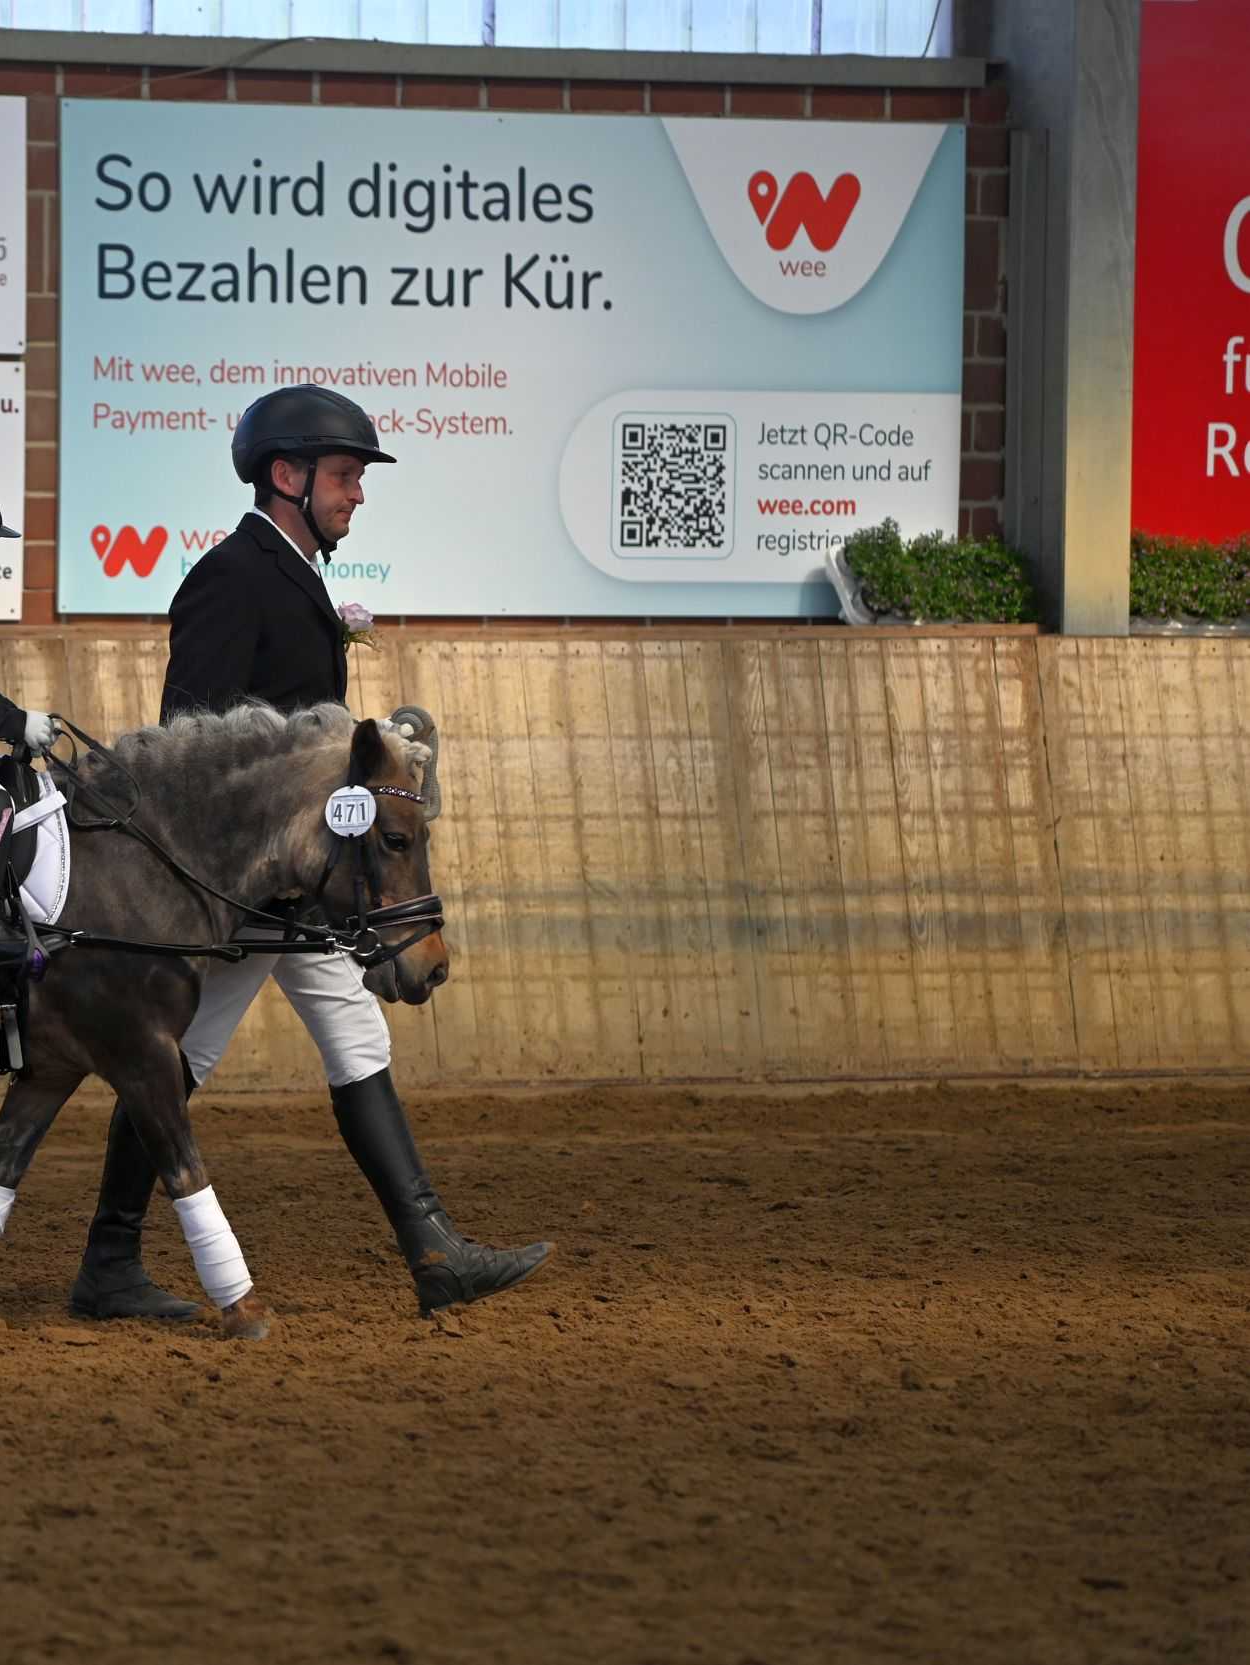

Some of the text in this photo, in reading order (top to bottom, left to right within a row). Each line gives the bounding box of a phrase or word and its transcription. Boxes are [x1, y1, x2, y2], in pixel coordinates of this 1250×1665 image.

[95, 154, 594, 233] So wird digitales
[98, 243, 613, 311] Bezahlen zur Kür.
[779, 259, 827, 277] wee
[92, 356, 507, 389] Mit wee, dem innovativen Mobile
[0, 397, 20, 414] u.
[93, 403, 217, 438] Payment-
[758, 422, 914, 450] Jetzt QR-Code
[758, 459, 932, 482] scannen und auf
[757, 498, 856, 516] wee.com
[180, 529, 228, 550] we
[757, 529, 848, 556] registrie
[319, 562, 391, 583] money
[333, 801, 366, 822] 471
